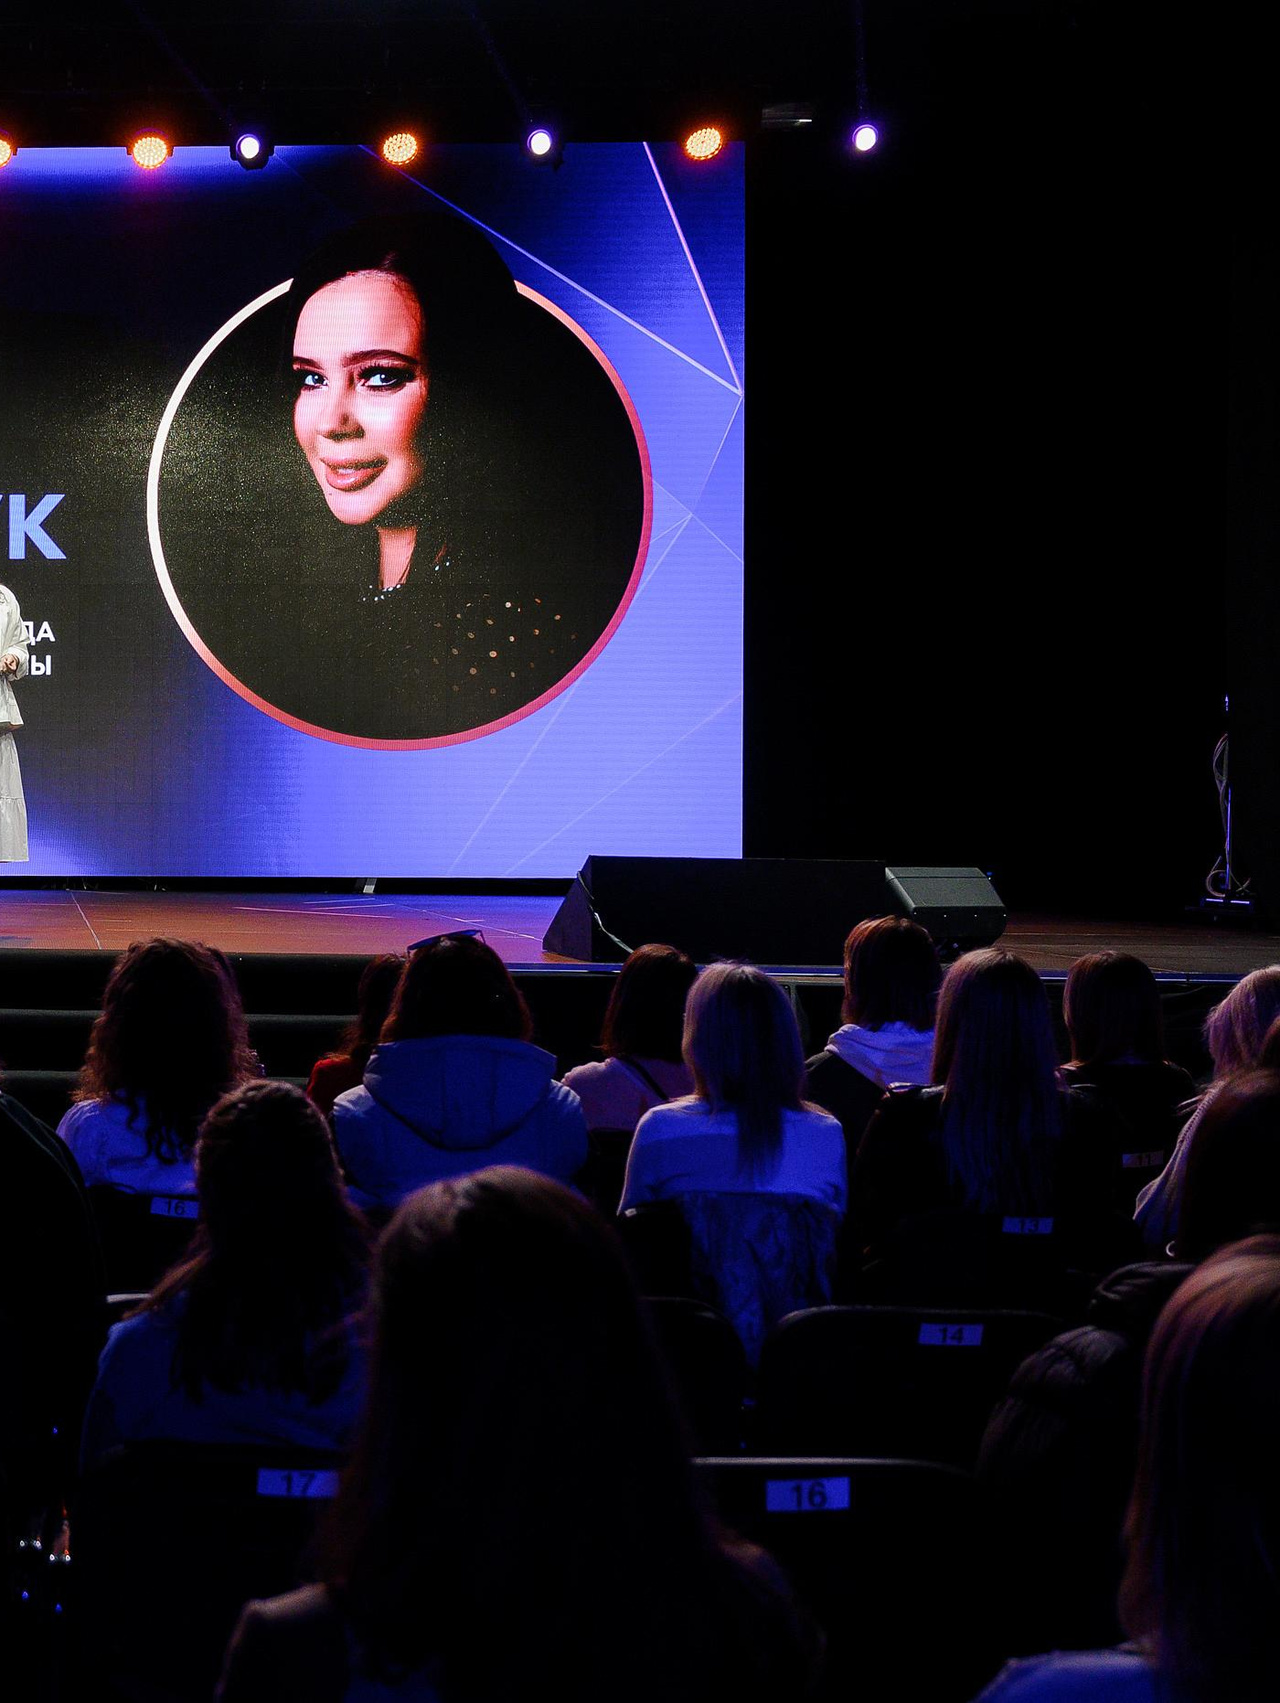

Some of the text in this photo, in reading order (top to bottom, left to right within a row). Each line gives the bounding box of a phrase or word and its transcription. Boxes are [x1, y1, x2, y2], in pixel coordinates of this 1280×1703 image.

[166, 1200, 185, 1215] 16
[1019, 1219, 1039, 1232] 13
[938, 1327, 963, 1344] 14
[280, 1471, 317, 1495] 17
[791, 1481, 827, 1510] 16
